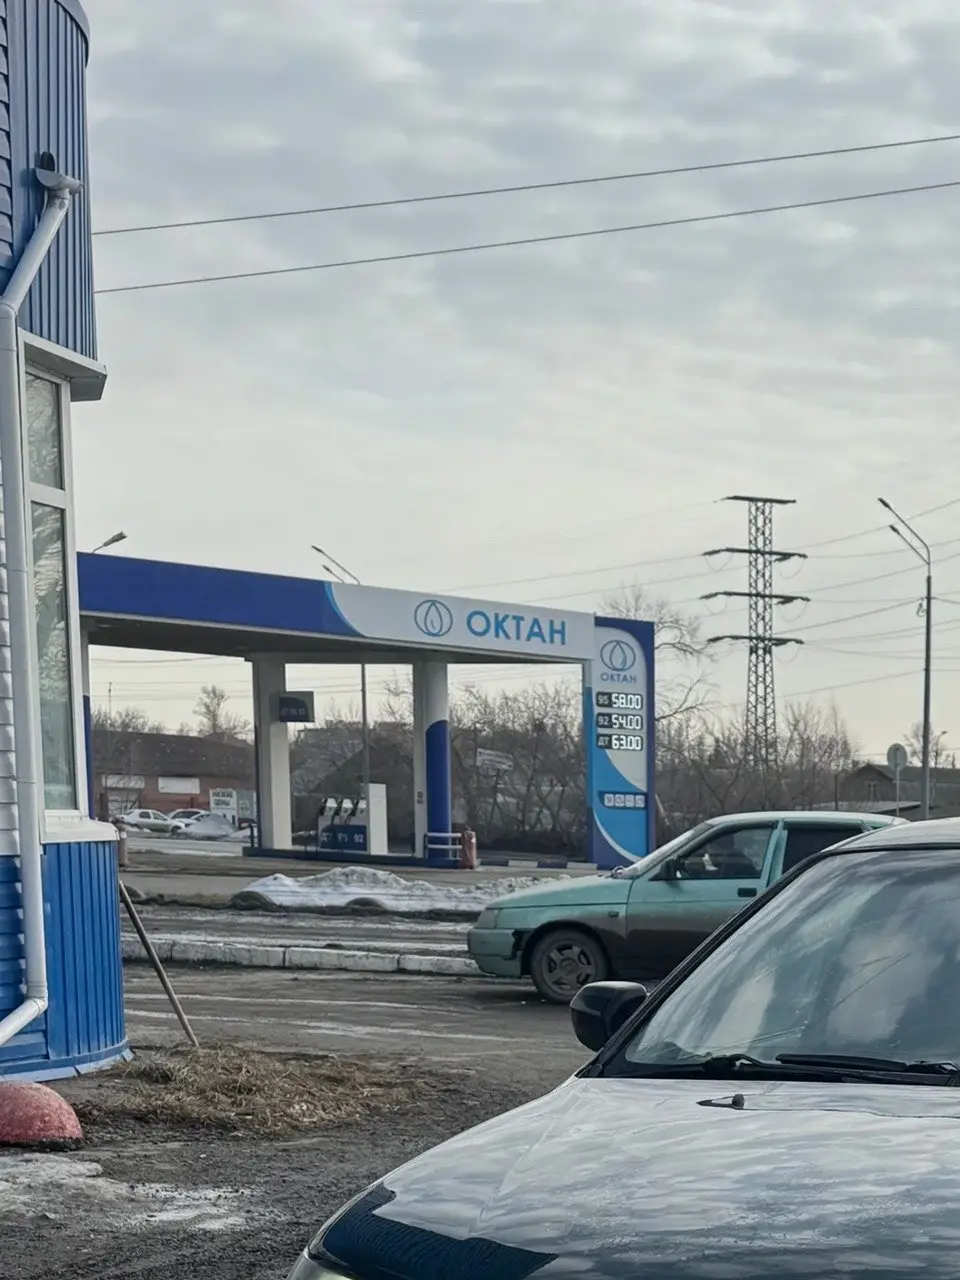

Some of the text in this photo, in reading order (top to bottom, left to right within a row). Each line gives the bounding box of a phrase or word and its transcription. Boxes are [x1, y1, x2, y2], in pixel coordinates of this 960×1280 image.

[466, 610, 566, 645] ОКТАН
[601, 672, 637, 684] ОКТАН
[611, 693, 642, 709] 58.00
[598, 714, 642, 730] 92 54.00
[598, 735, 642, 750] ДТ 63.00
